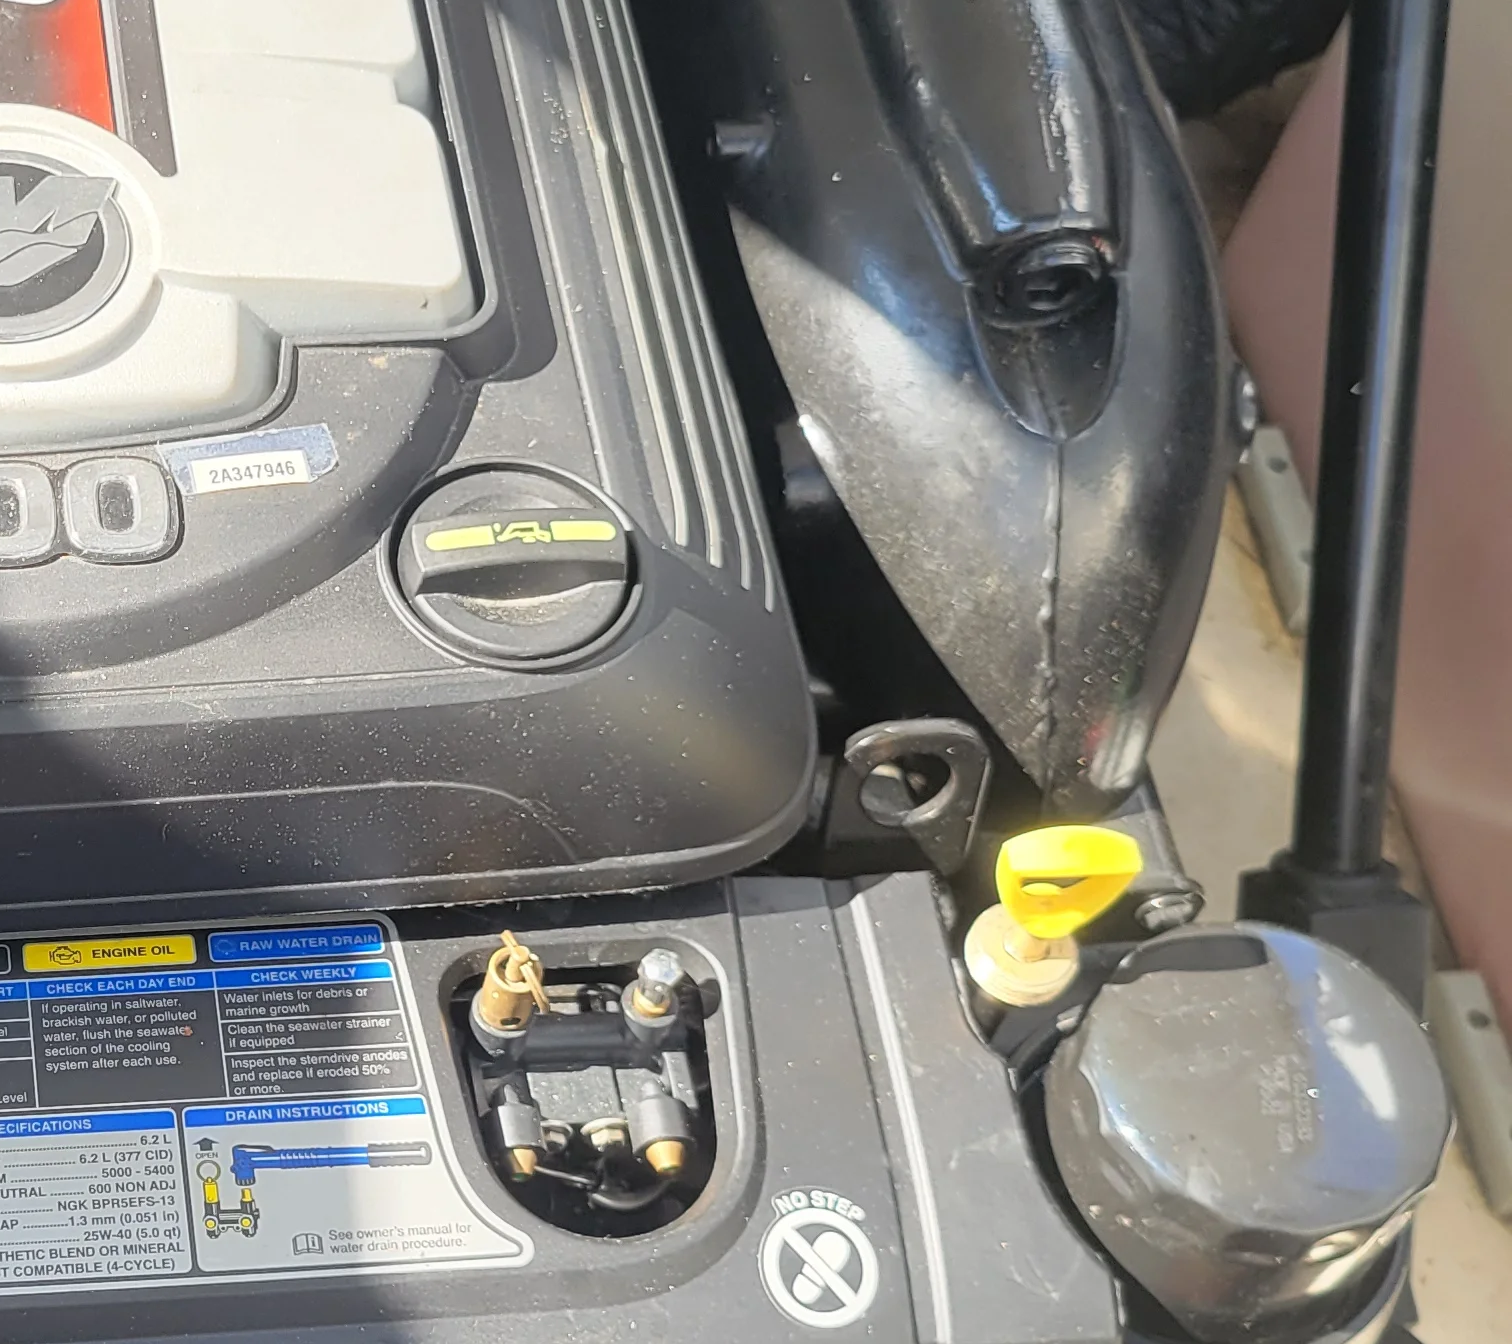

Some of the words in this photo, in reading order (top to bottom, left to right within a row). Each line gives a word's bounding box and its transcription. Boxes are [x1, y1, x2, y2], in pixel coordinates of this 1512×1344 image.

[197, 455, 307, 493] 2A347946
[239, 940, 272, 950] RAW
[277, 937, 328, 948] WATER
[332, 934, 378, 946] DRAIN
[91, 946, 146, 958] ENGINE
[150, 945, 175, 955] OIL
[250, 970, 298, 982] CHECK
[301, 966, 356, 979] WEEKLY
[46, 982, 93, 994] CHECK
[97, 980, 134, 991] EACH
[138, 978, 164, 988] DAY
[167, 976, 195, 987] END
[223, 993, 258, 1003] Water
[262, 991, 293, 1001] inlets
[296, 989, 312, 999] for
[315, 988, 353, 998] debris
[355, 987, 368, 996] or
[225, 1005, 266, 1016] marine
[269, 1002, 310, 1016] growth
[227, 1024, 263, 1034] Clean
[265, 1022, 284, 1032] the
[287, 1020, 342, 1031] seawater
[346, 1017, 392, 1028] strainer
[229, 1038, 236, 1047] if
[239, 1035, 295, 1048] equipped
[225, 1109, 272, 1121] DRAIN
[276, 1101, 389, 1117] INSTRUCTIONS
[140, 1134, 159, 1145] 6.2
[162, 1134, 171, 1144] L
[79, 1153, 98, 1164] 6.2
[102, 1152, 111, 1162] L
[114, 1151, 141, 1164] (377
[144, 1149, 173, 1161] CID)
[195, 1151, 218, 1159] OPEN
[101, 1166, 132, 1178] 5000
[144, 1164, 174, 1175] 5400
[88, 1183, 111, 1194] 600
[115, 1181, 145, 1192] NON
[149, 1179, 176, 1190] ADJ
[57, 1199, 88, 1211] NGK
[91, 1195, 175, 1209] BPR5EFS-13
[775, 1191, 809, 1215] NO
[810, 1190, 867, 1222] STEP
[68, 1215, 87, 1226] 1.3
[91, 1216, 116, 1225] mm
[119, 1211, 157, 1225] (0.051
[162, 1210, 179, 1223] in)
[83, 1229, 132, 1241] 25W-40
[135, 1227, 159, 1241] (5.0
[163, 1226, 181, 1239] qt)
[48, 1246, 95, 1259] BLEND
[98, 1245, 119, 1256] OR
[122, 1242, 185, 1254] MINERAL
[13, 1262, 102, 1276] COMPATIBLE
[106, 1258, 175, 1273] (4-CYCLE)
